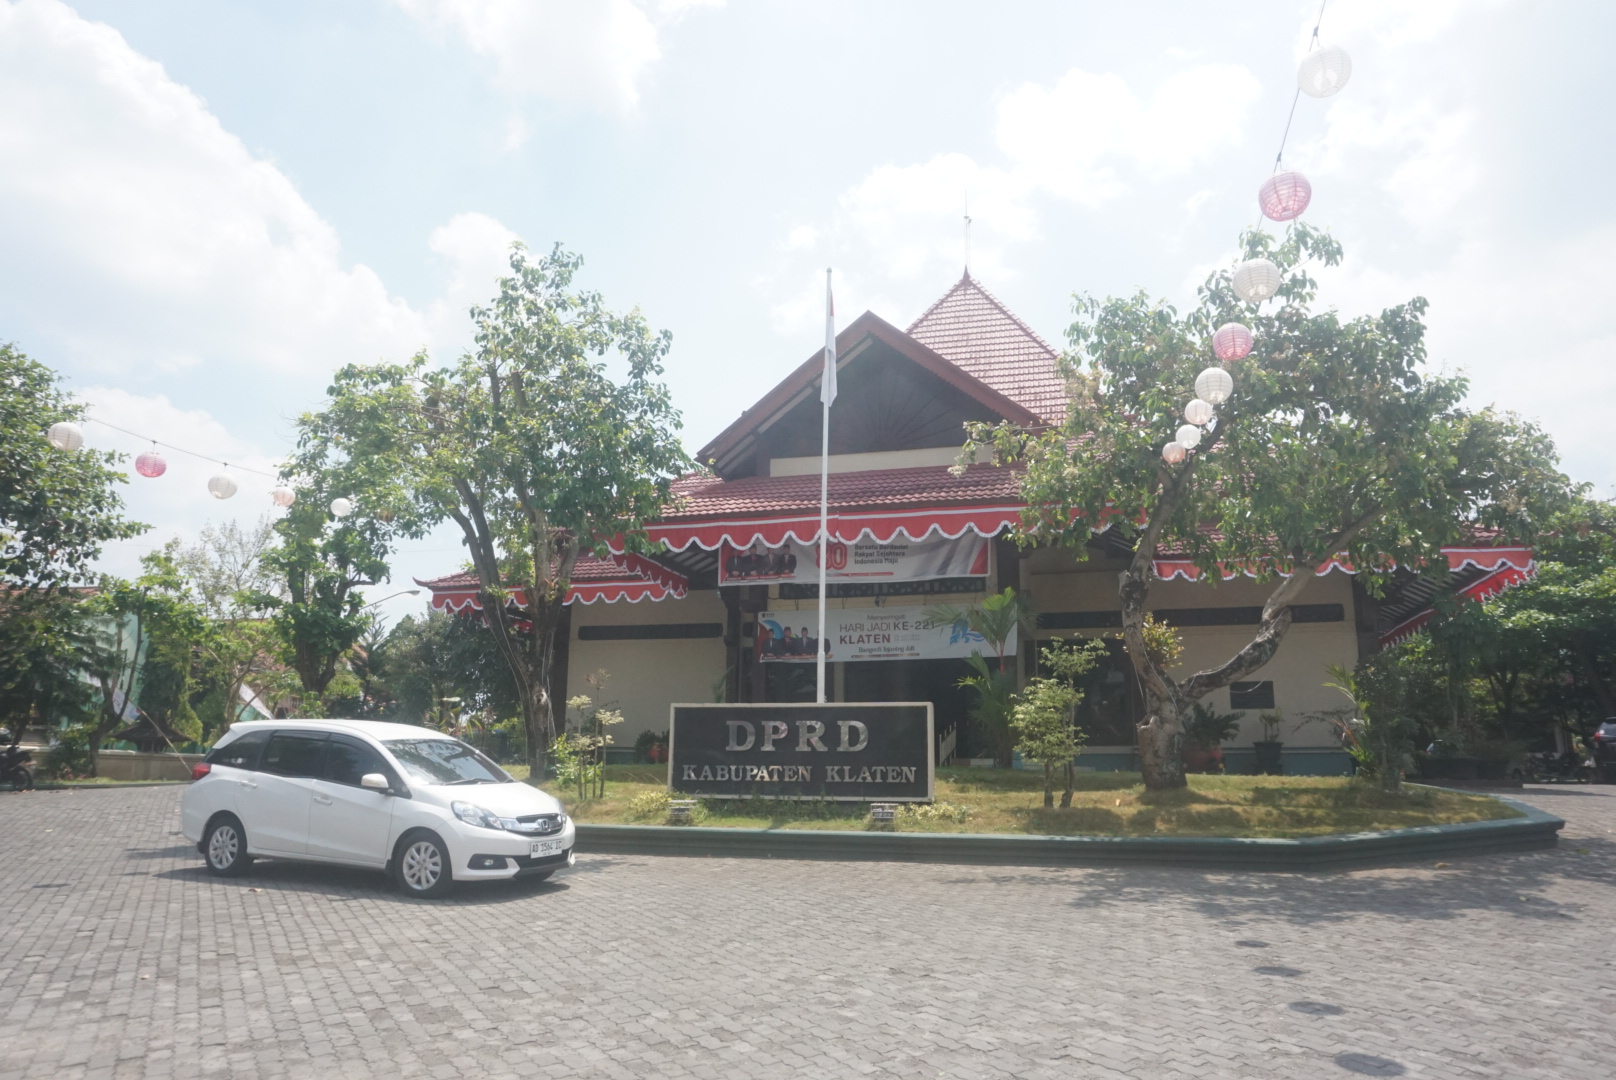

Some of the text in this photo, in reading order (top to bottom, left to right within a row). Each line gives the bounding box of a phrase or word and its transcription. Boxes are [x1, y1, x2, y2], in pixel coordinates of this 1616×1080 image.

[884, 557, 899, 565] Maju
[839, 623, 865, 632] HARI
[867, 622, 891, 631] JADI
[839, 634, 891, 645] KLATEN
[725, 719, 869, 752] DPRD
[682, 764, 917, 783] KABUPATEN KLATEN
[532, 844, 539, 853] AD
